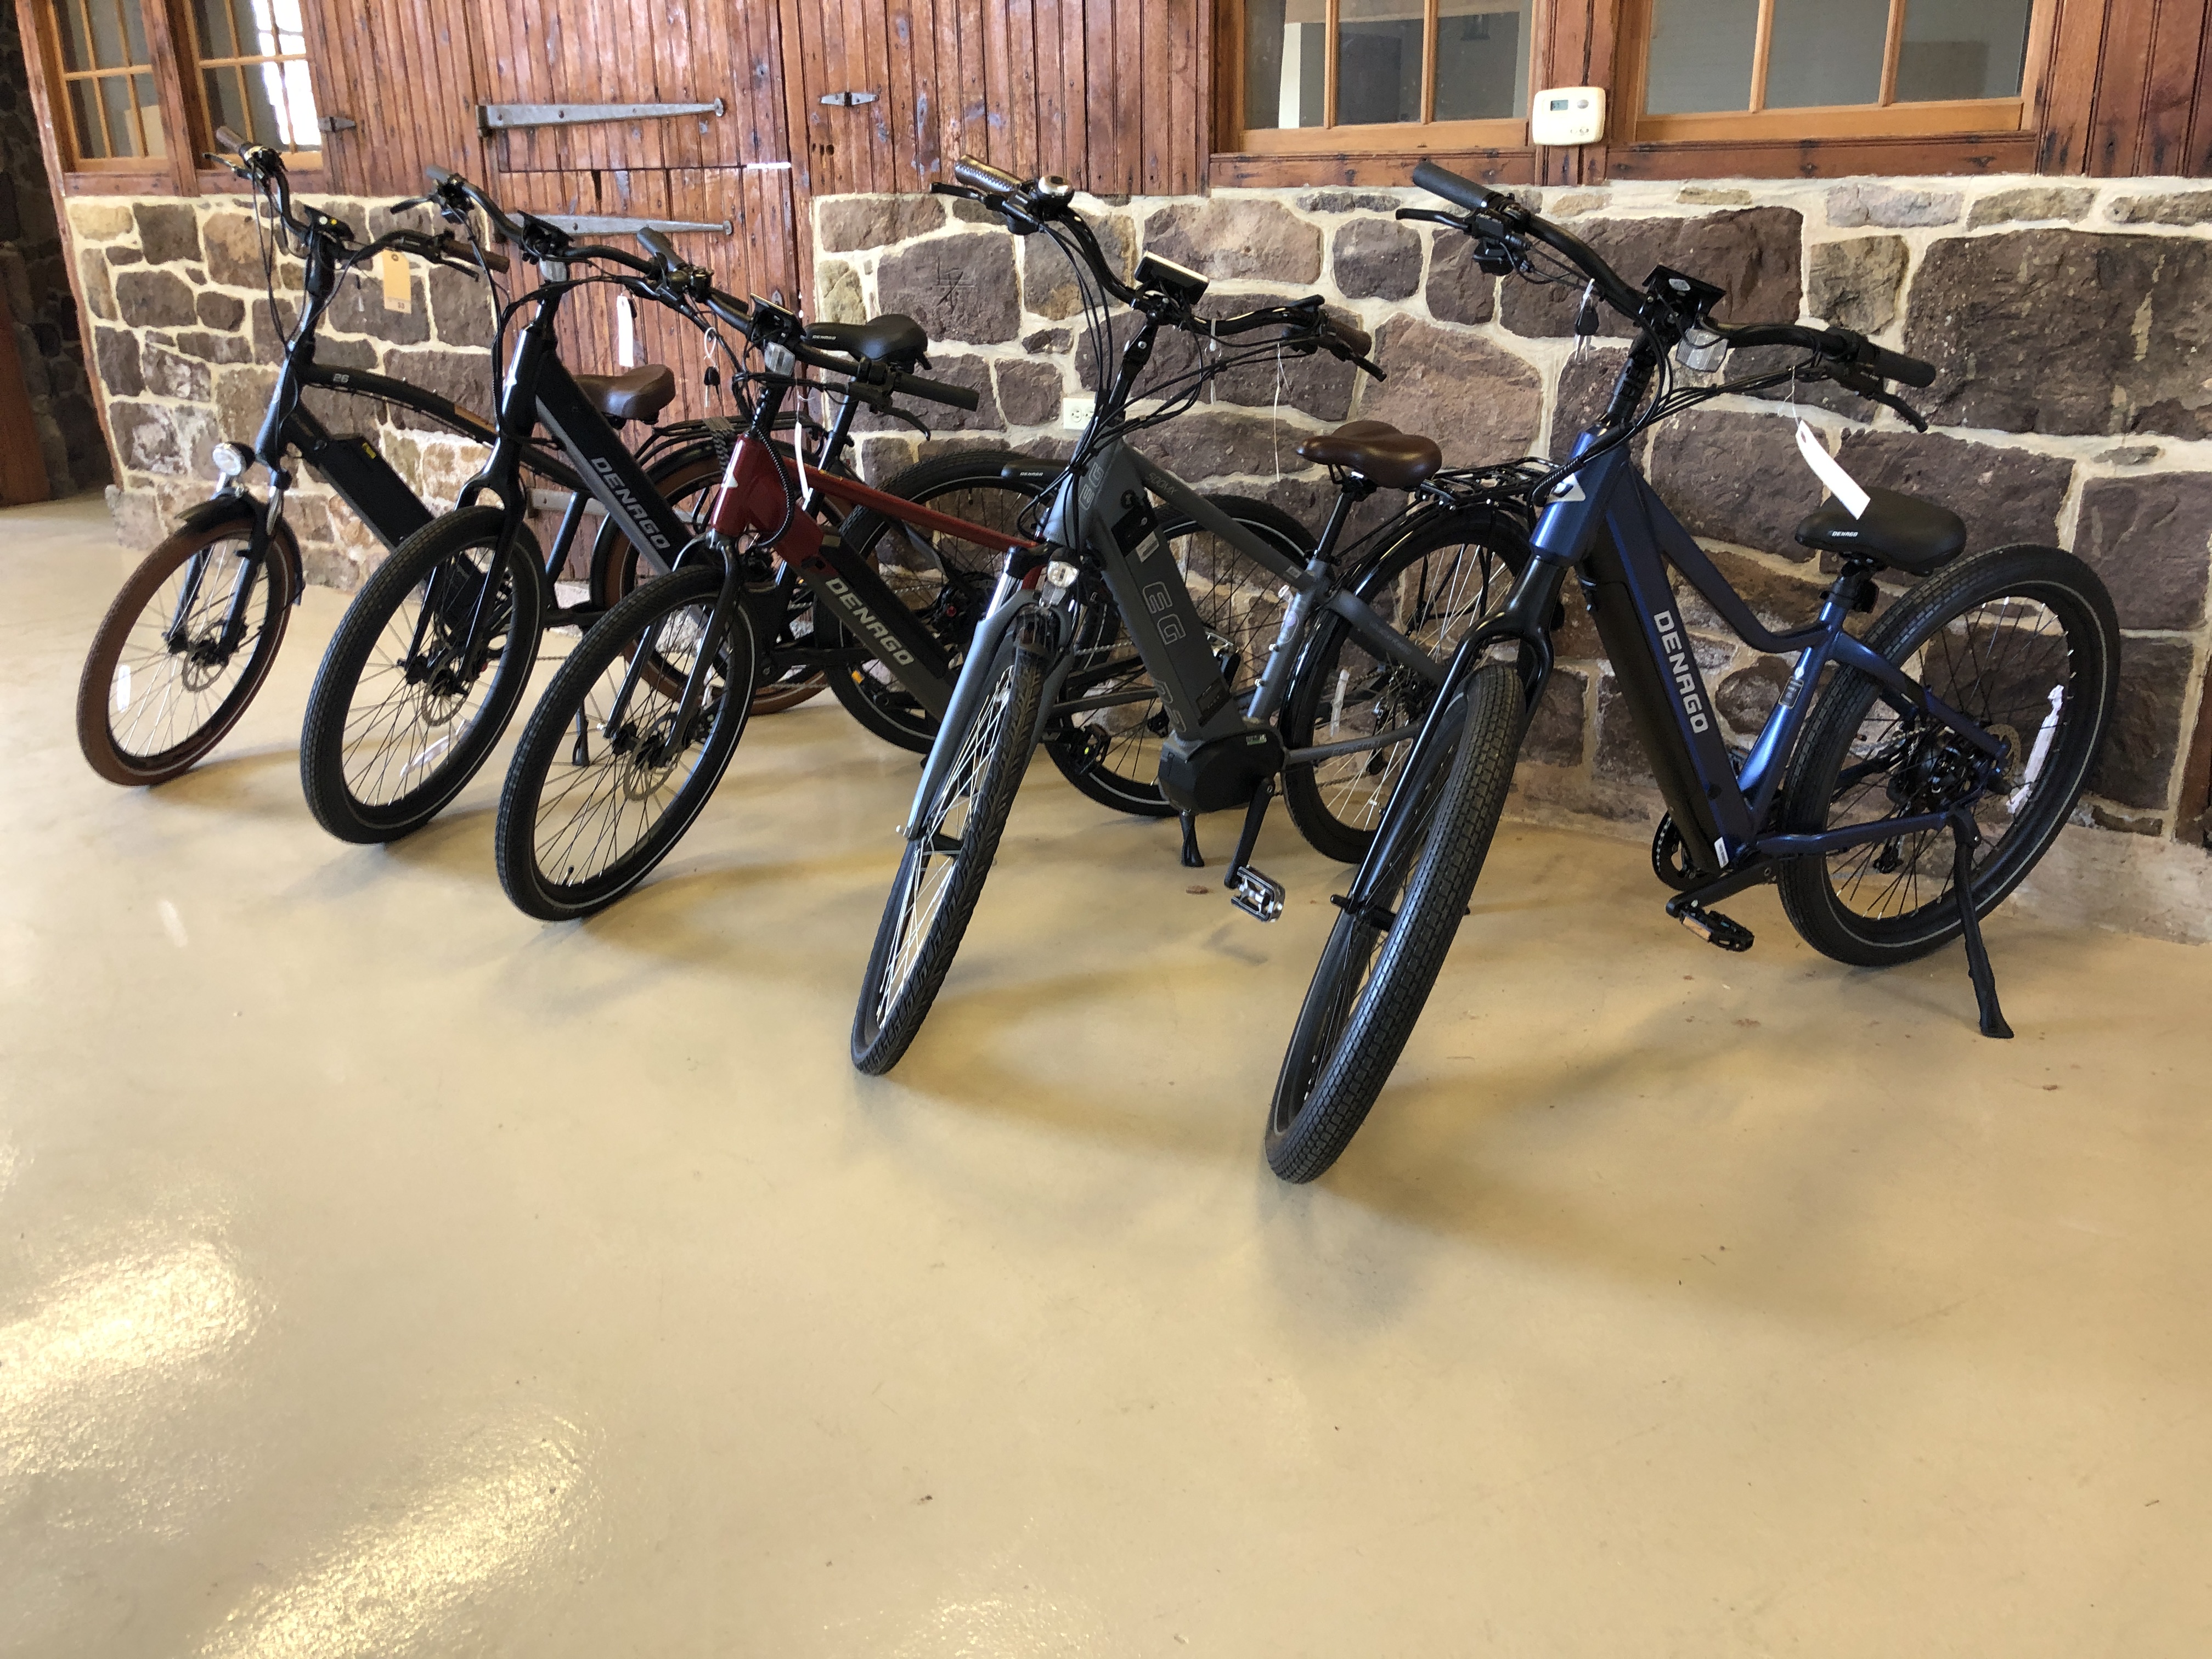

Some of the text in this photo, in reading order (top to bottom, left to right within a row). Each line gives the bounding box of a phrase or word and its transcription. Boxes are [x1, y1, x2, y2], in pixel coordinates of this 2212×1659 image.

[591, 457, 670, 549] DENAGO
[825, 577, 915, 666] DENAGO
[1142, 581, 1186, 645] EG
[1654, 610, 1708, 733] DENAGO
